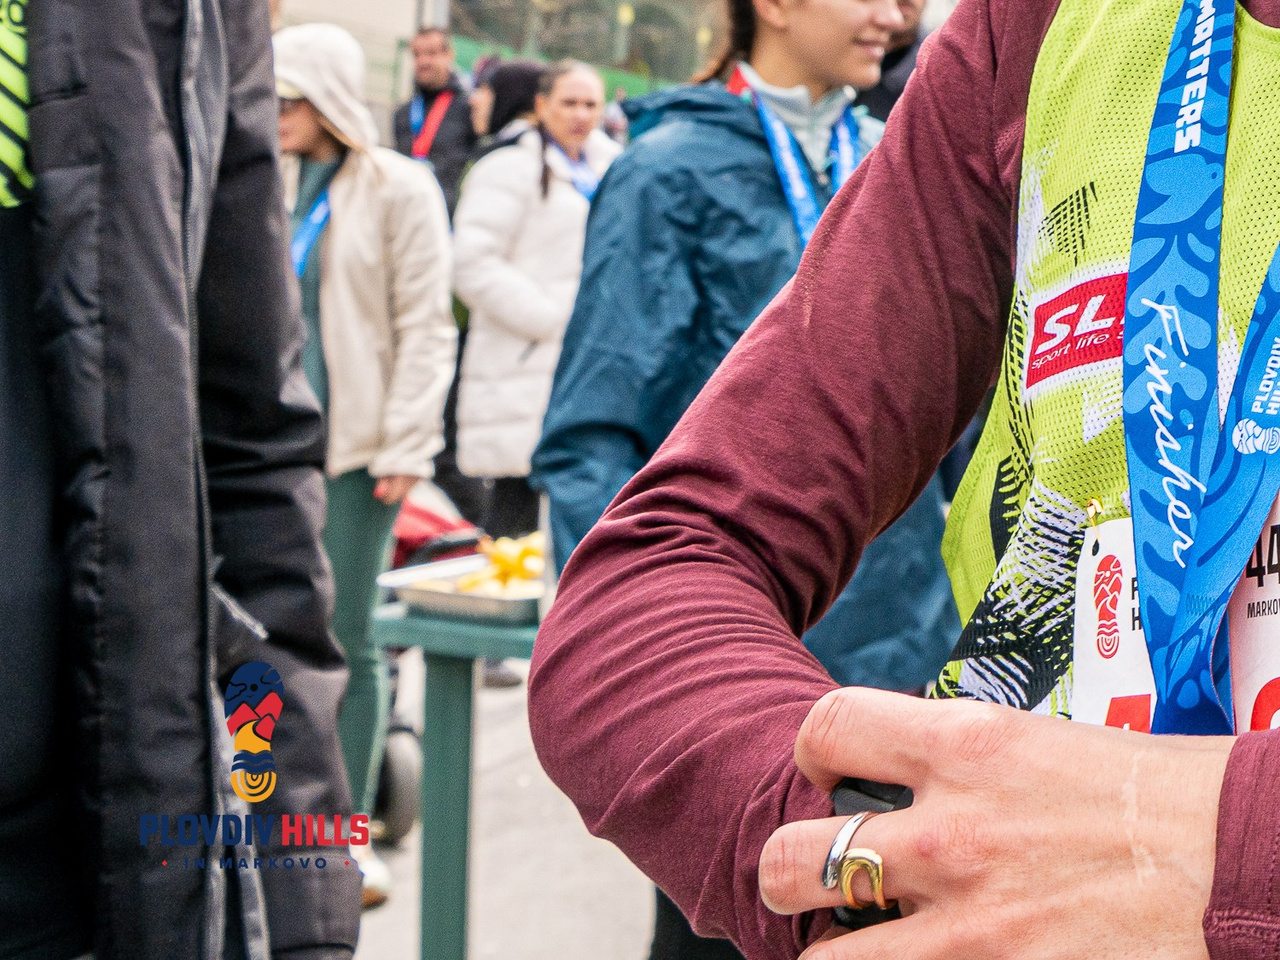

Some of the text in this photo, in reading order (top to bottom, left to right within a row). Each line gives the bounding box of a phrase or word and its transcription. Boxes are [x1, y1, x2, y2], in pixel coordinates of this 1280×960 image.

[1031, 343, 1071, 369] sport
[1076, 334, 1109, 350] life
[1034, 294, 1124, 355] SL
[1142, 298, 1207, 569] Finisher
